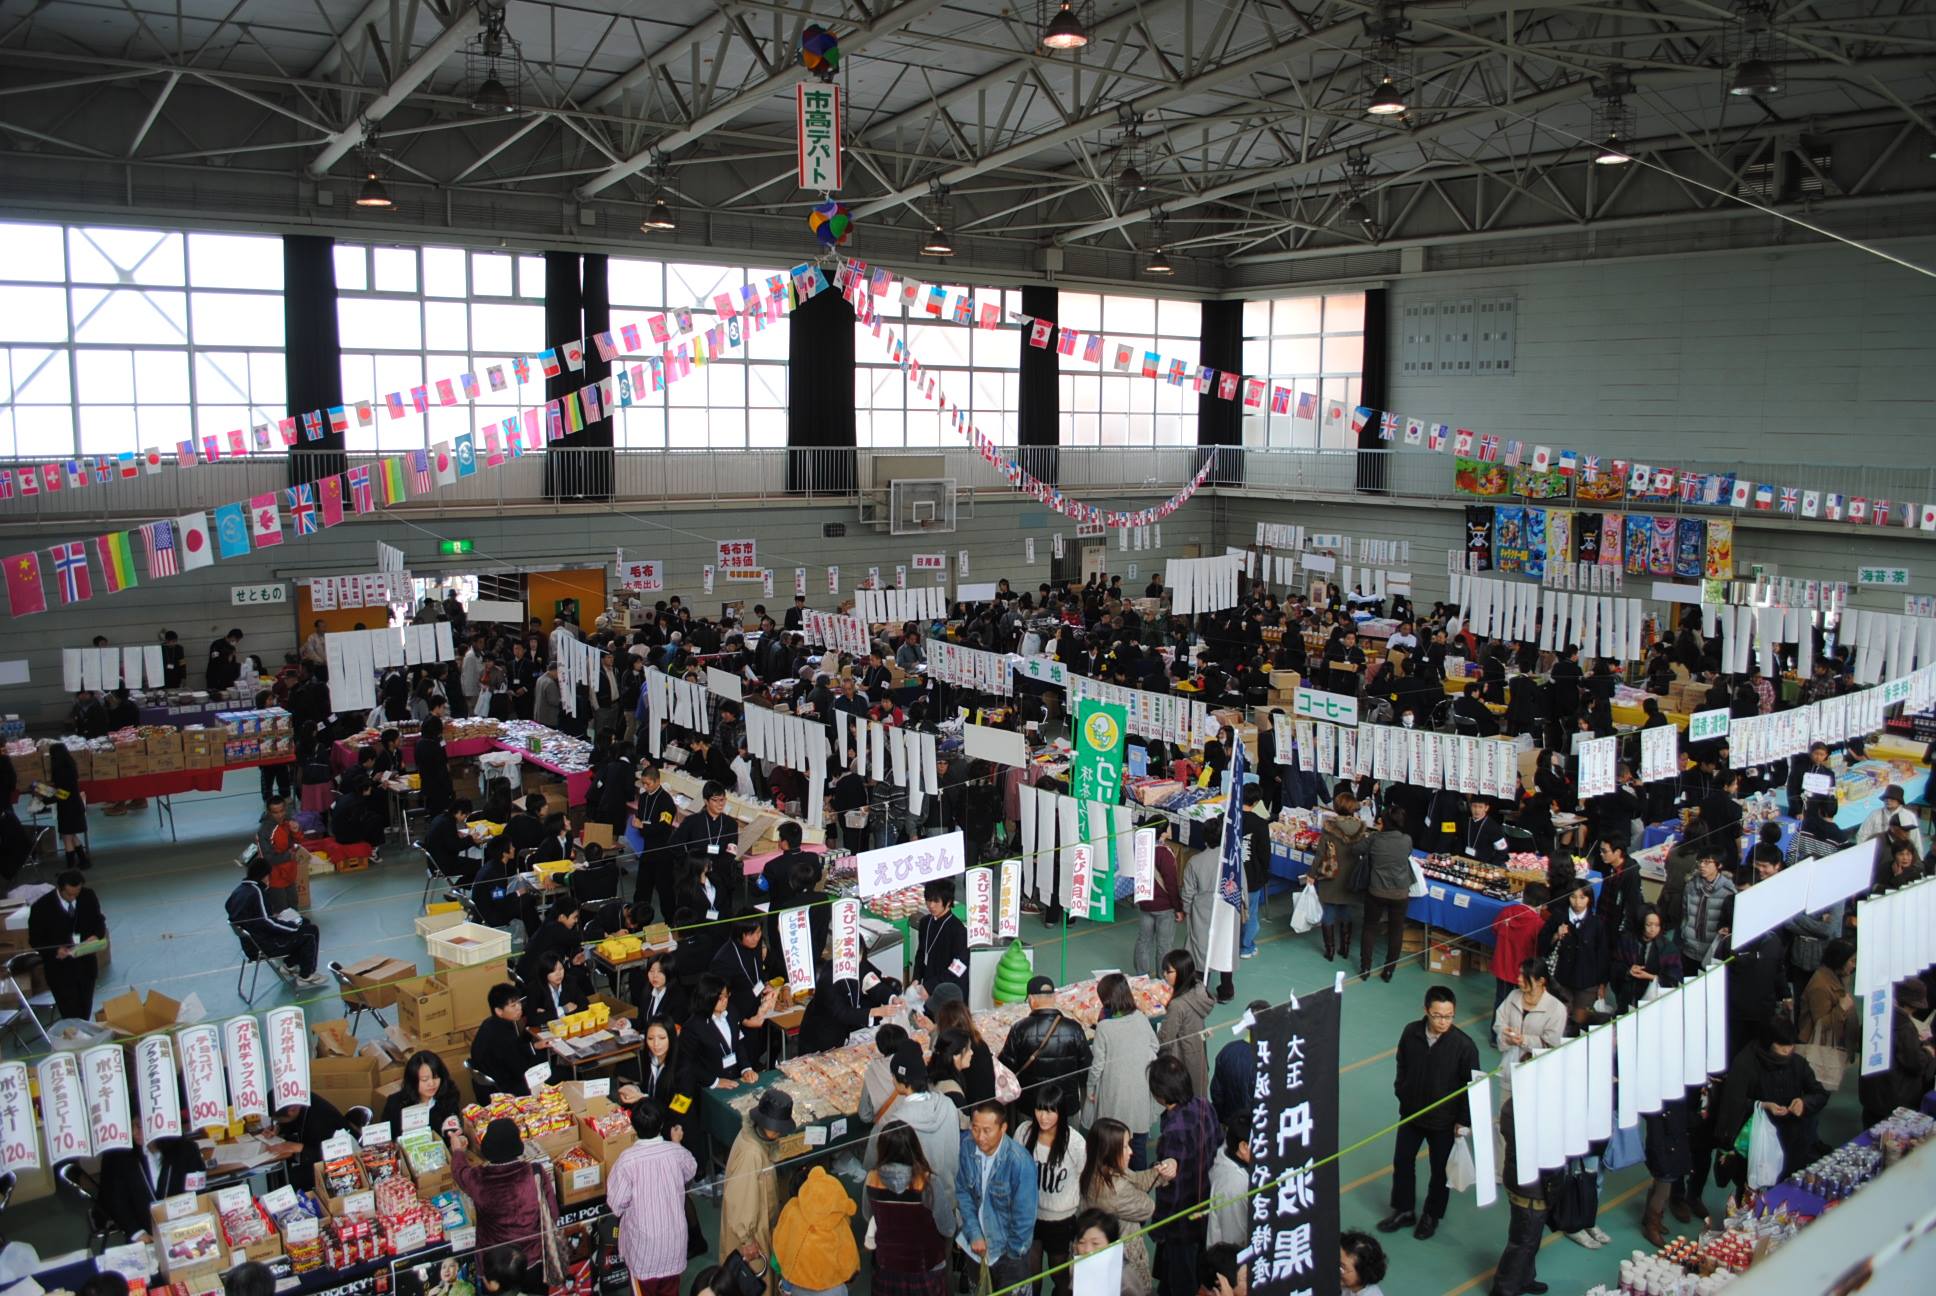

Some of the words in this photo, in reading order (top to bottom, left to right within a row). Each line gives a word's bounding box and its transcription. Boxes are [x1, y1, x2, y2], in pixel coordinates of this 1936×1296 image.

[804, 90, 832, 184] 市高デパート
[720, 543, 753, 555] 毛布市
[630, 565, 653, 578] 毛布
[720, 556, 753, 569] 大特価
[917, 557, 941, 567] 日用品
[236, 587, 282, 602] せともの
[624, 580, 661, 590] 大売出し
[1029, 660, 1062, 682] 布地
[1298, 693, 1353, 718] コーヒー
[873, 847, 955, 887] えびせん
[978, 872, 990, 925] えびつまみ
[842, 903, 857, 959] えびつまみ
[969, 926, 991, 939] 250円
[789, 968, 812, 986] 250円
[834, 961, 857, 975] 250円
[113, 1048, 123, 1073] グリコ
[195, 1035, 214, 1082] チョコパイ
[236, 1023, 255, 1090] ガルボチップス
[16, 1065, 26, 1091] グリコ
[145, 1041, 163, 1114] ブラックチョコレート
[185, 1043, 202, 1103] パーティーパック
[96, 1058, 115, 1113] ポッキー
[276, 1080, 307, 1101] 130円
[0, 1075, 19, 1132] ポッキー
[193, 1100, 226, 1121] 300円
[236, 1089, 266, 1110] 130円
[146, 1113, 177, 1133] 70円
[54, 1132, 88, 1153] 70円
[94, 1123, 129, 1146] 120円
[1, 1142, 36, 1166] 120円
